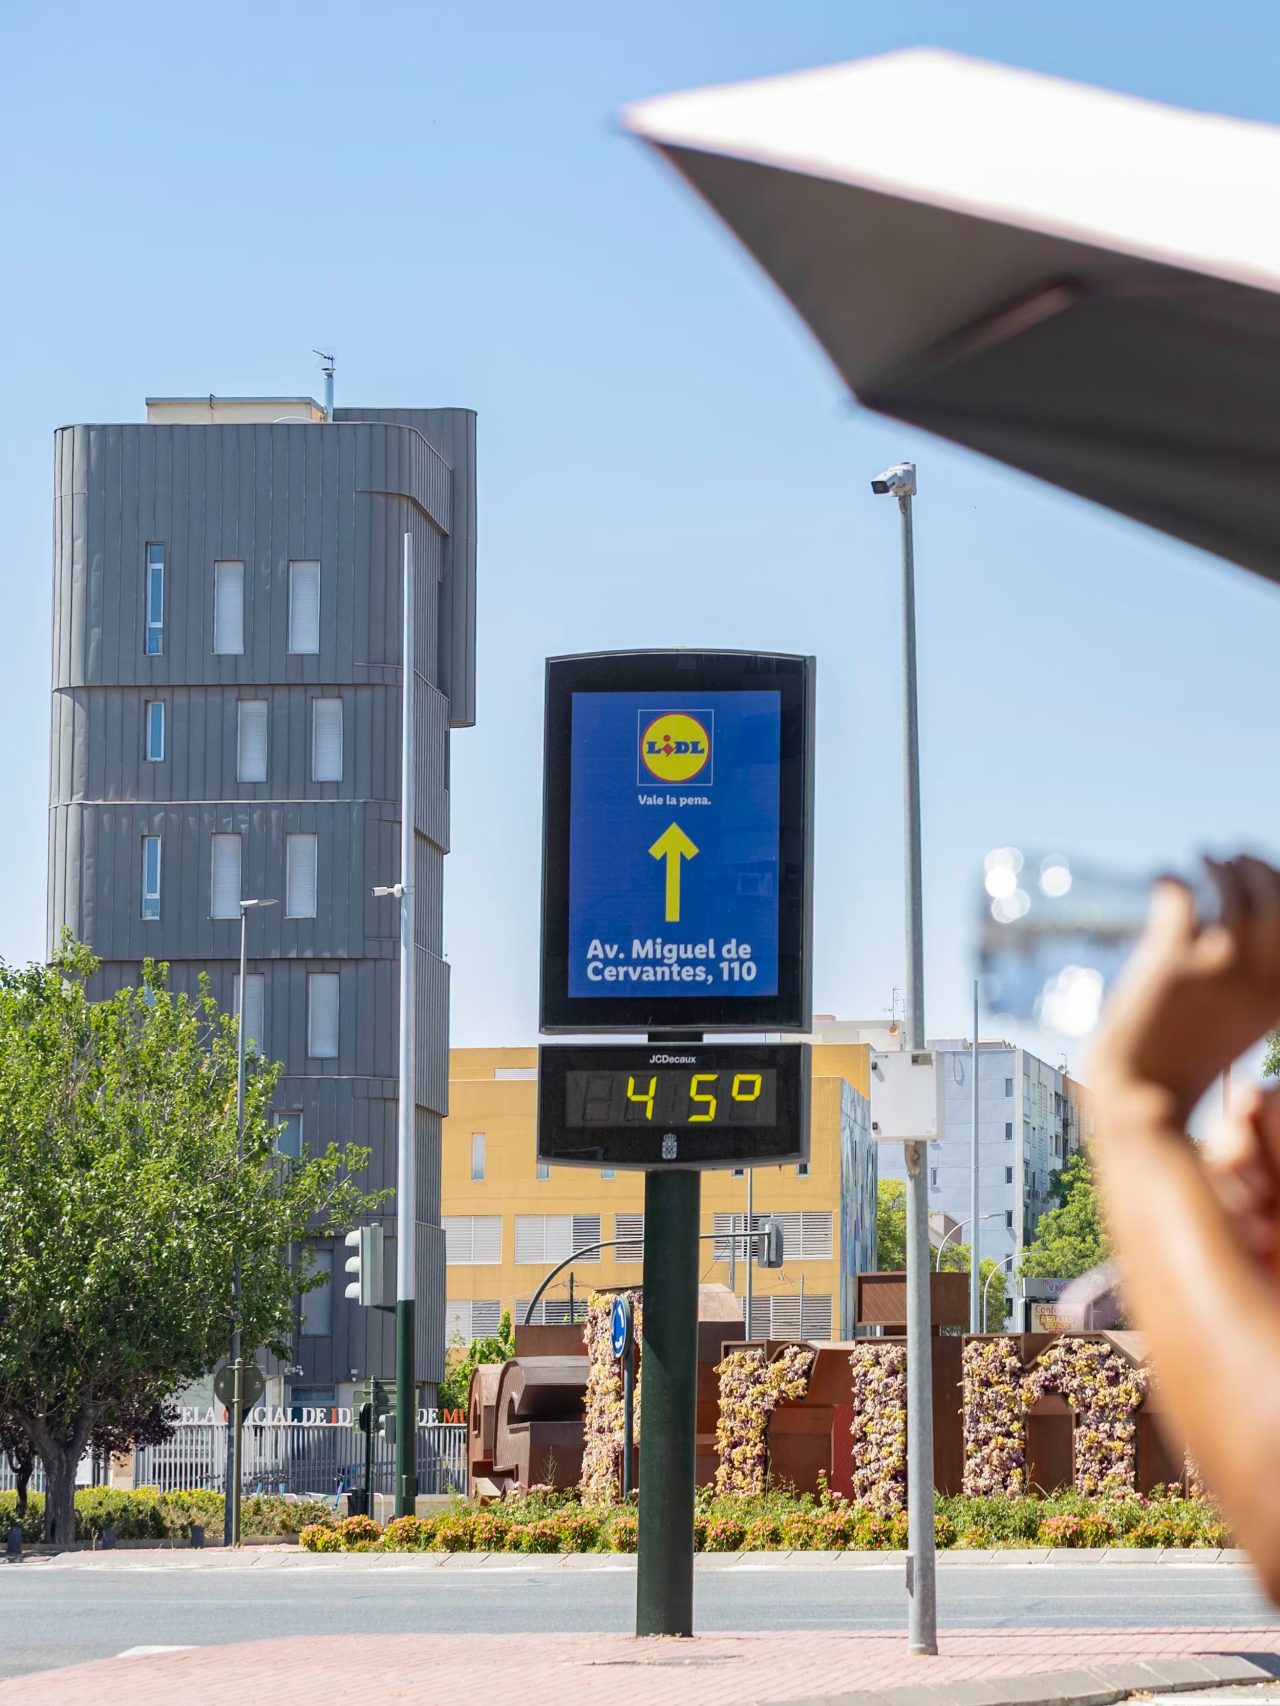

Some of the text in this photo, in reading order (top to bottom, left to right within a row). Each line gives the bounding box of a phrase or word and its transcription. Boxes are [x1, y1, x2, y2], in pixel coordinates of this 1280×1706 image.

[638, 795, 712, 807] Vale la pena.
[586, 937, 752, 964] Av. Miguel de
[586, 961, 757, 985] Cervantes, 110
[649, 1054, 696, 1064] JCDecaux
[301, 1407, 327, 1426] DE
